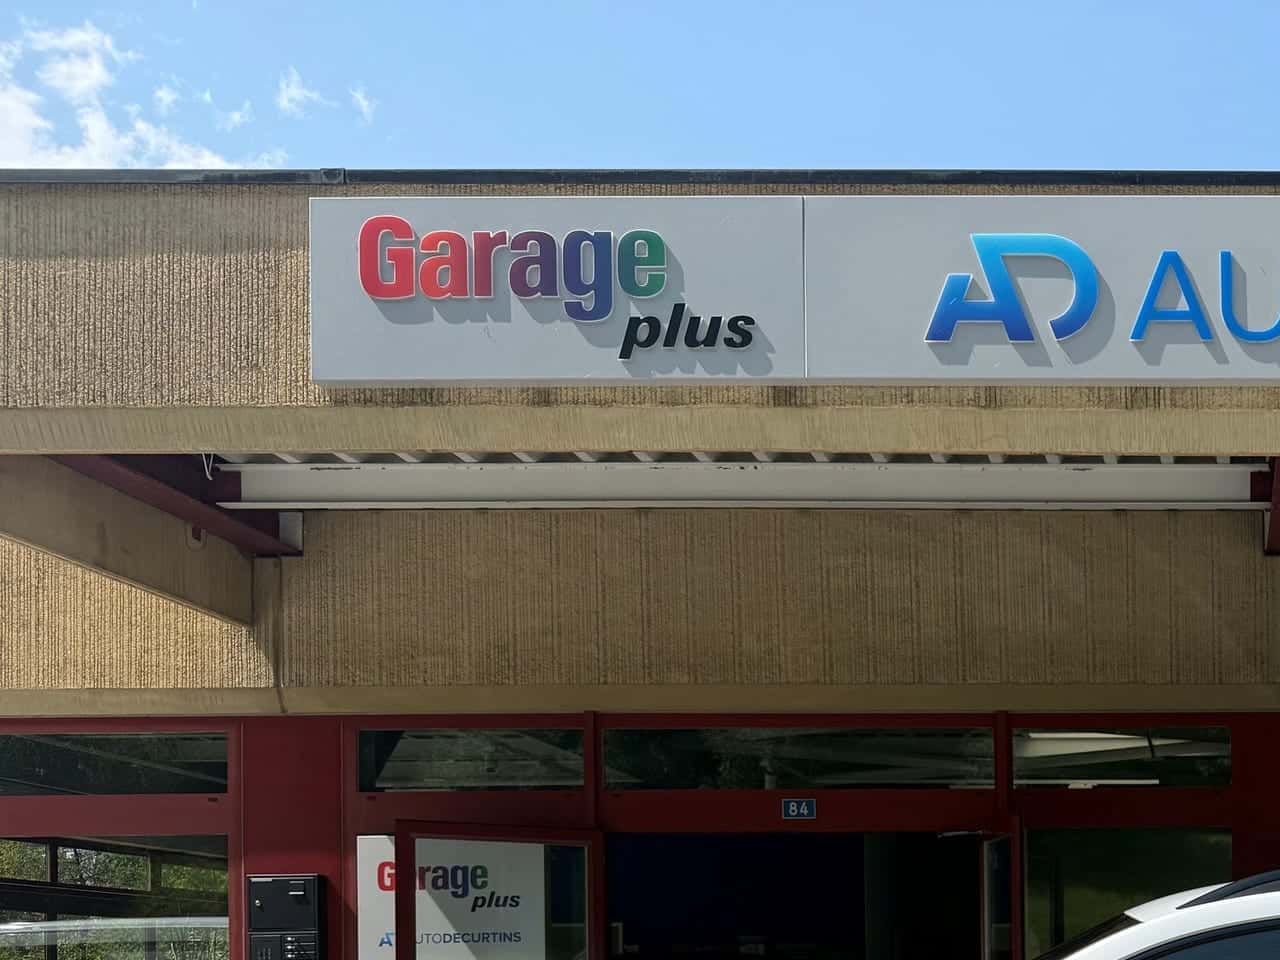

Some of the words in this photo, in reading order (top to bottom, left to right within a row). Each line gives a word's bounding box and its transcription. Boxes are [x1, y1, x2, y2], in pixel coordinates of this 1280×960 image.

[358, 214, 668, 322] Garage
[924, 232, 1098, 342] AD
[617, 303, 756, 361] plus
[788, 801, 809, 816] 84
[377, 861, 489, 899] Grage
[470, 891, 521, 912] plus
[416, 931, 522, 945] UTODECURTINS
